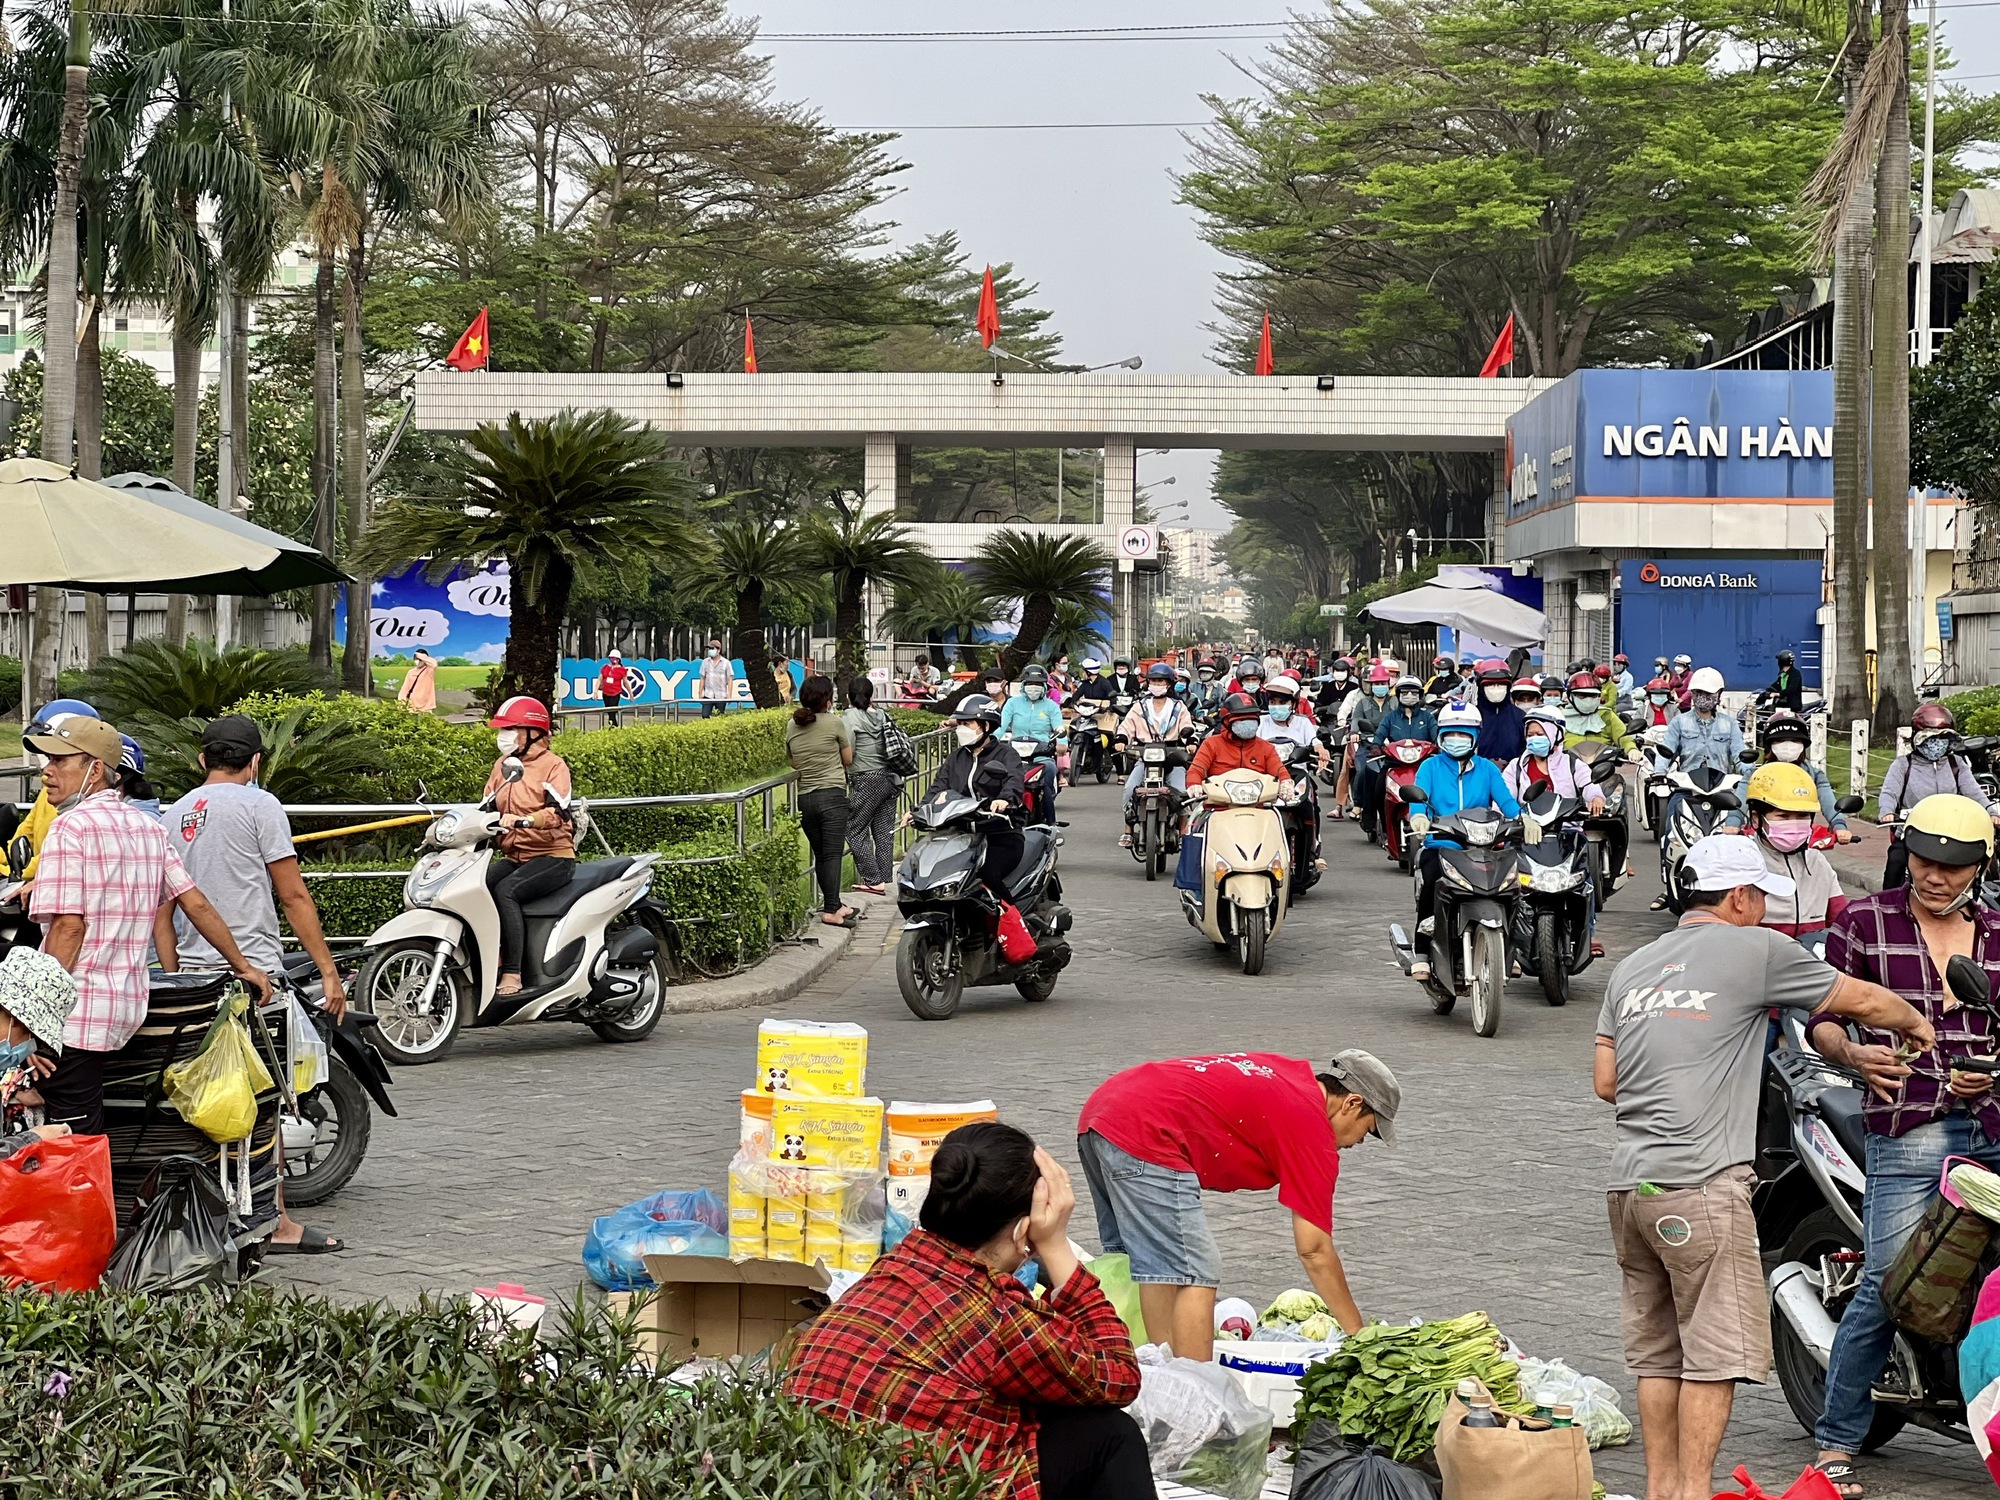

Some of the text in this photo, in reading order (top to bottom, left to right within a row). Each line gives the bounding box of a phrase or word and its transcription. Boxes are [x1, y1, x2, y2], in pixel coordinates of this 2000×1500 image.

[1603, 417, 1728, 457] NGÂN
[1741, 417, 1833, 458] HÀN
[1660, 573, 1757, 588] DONGA Bank
[468, 585, 511, 606] Vu
[370, 617, 428, 638] Vui
